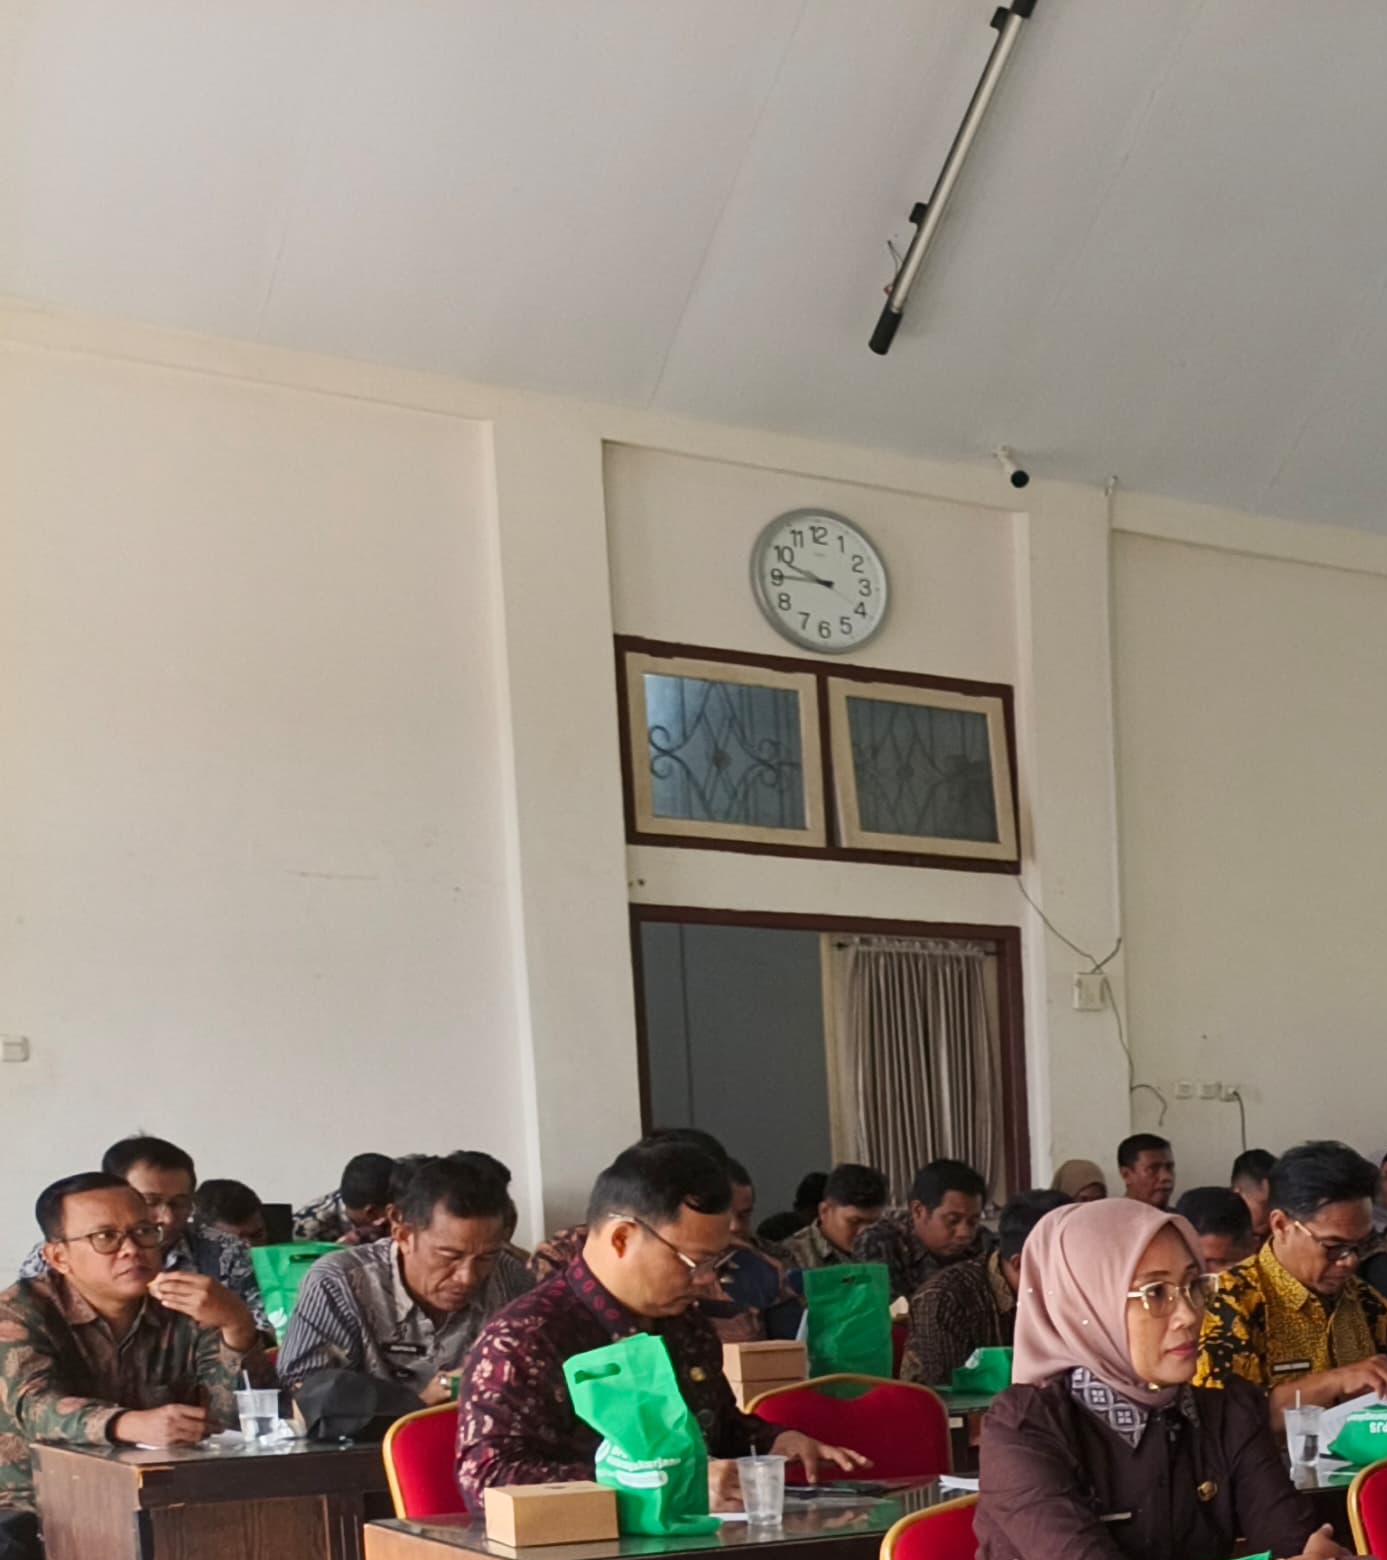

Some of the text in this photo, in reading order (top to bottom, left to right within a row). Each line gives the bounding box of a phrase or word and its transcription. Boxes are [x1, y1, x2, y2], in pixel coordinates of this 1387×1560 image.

[790, 530, 804, 548] 11
[809, 526, 828, 545] 12
[837, 536, 844, 552] 1
[774, 545, 794, 564] 10
[852, 555, 864, 573] 2
[770, 568, 784, 586] 9
[858, 578, 872, 597] 3
[778, 592, 791, 611] 8
[854, 602, 867, 619] 4
[798, 611, 811, 630] 7
[840, 617, 853, 635] 5
[818, 621, 831, 639] 6
